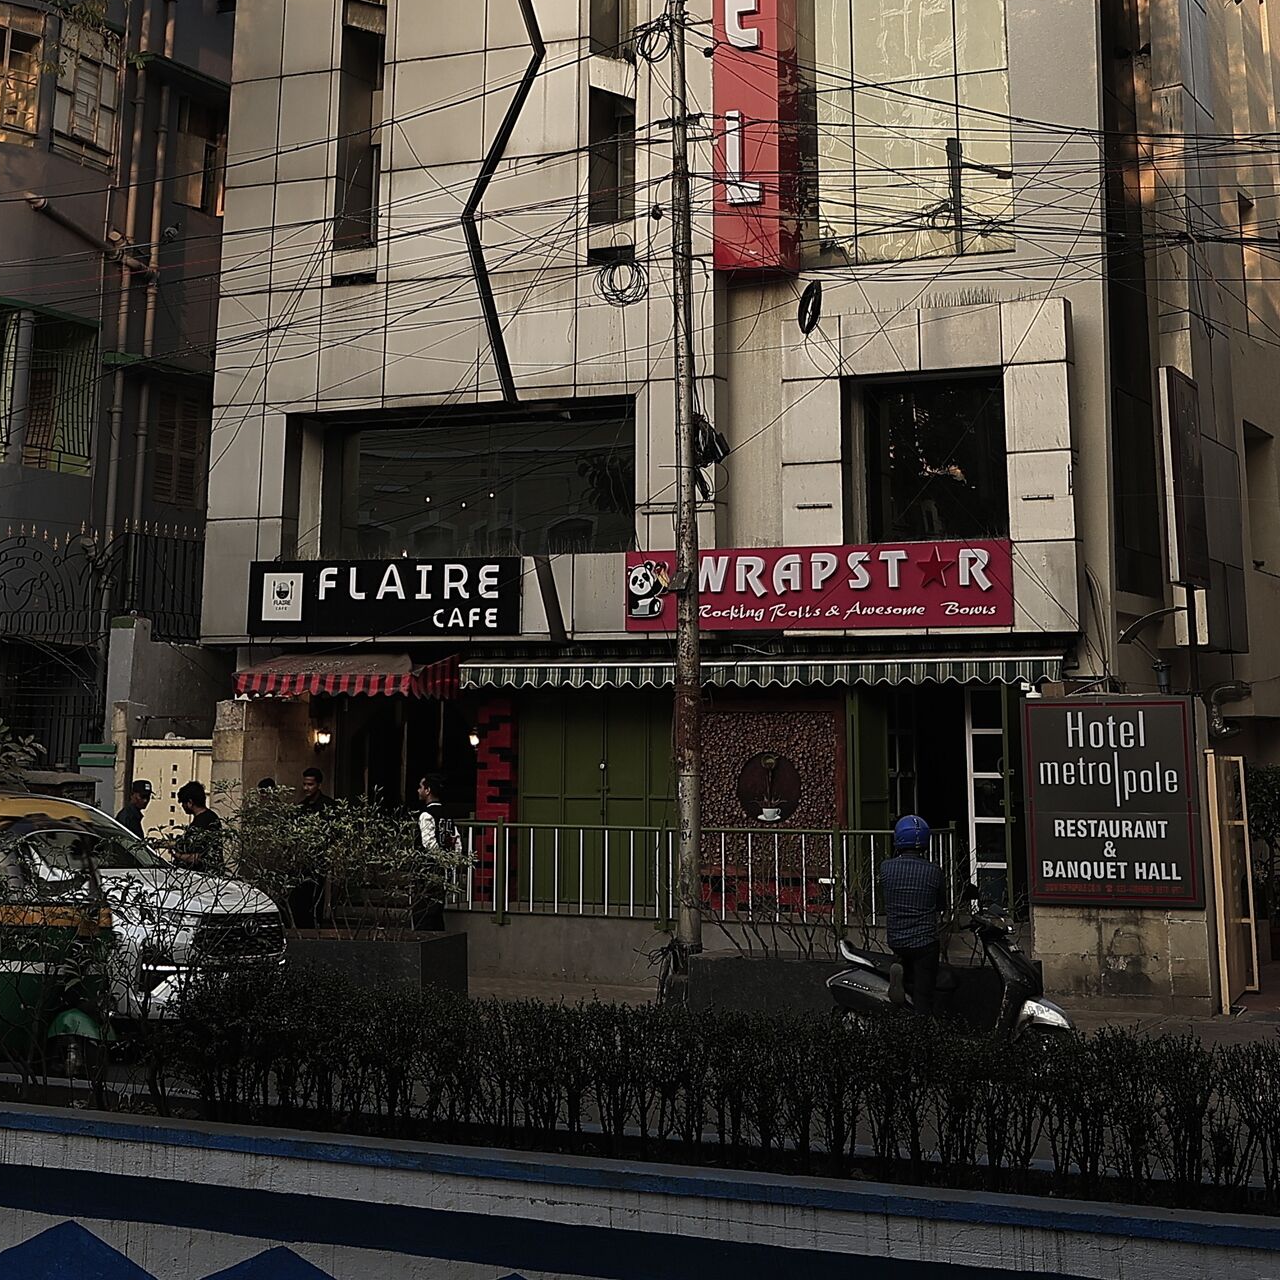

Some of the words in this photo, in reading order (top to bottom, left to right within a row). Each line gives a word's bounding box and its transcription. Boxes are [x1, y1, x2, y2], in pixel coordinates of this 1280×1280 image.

[318, 563, 500, 601] FLAIRE
[432, 607, 498, 629] CAFE
[698, 603, 765, 622] Rocking
[769, 602, 821, 622] Rolls
[825, 604, 840, 617] &
[842, 601, 926, 620] Awesome
[1066, 710, 1146, 749] Hotel
[1054, 818, 1169, 839] RESTAURANT
[1103, 840, 1117, 858] &
[1041, 860, 1128, 881] BANQUET
[1134, 861, 1182, 881] HALL
